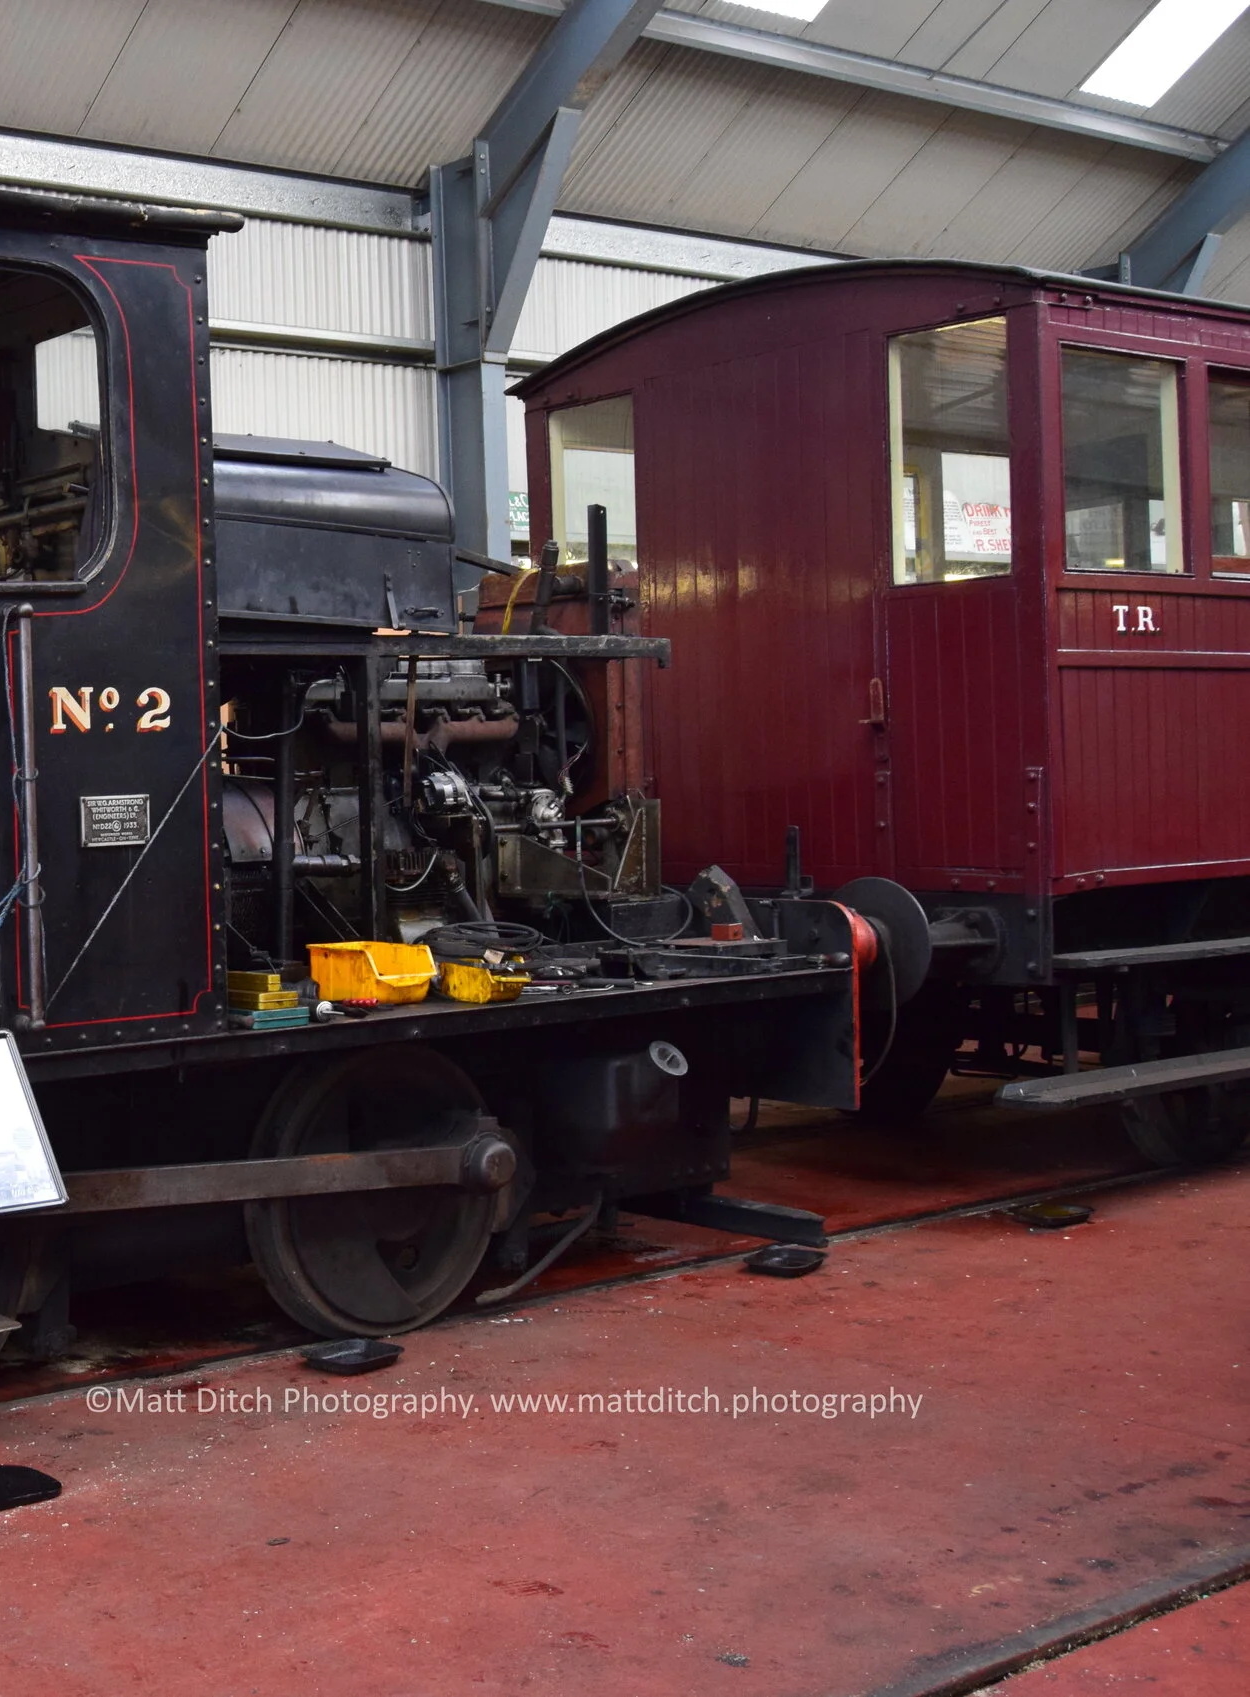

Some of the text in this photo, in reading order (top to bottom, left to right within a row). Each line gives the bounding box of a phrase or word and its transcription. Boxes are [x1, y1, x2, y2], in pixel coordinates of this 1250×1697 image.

[964, 503, 1001, 518] DRINK
[983, 527, 997, 535] BEST
[975, 538, 1011, 552] R.SHE
[1112, 605, 1161, 633] T.R.
[136, 686, 171, 733] 2
